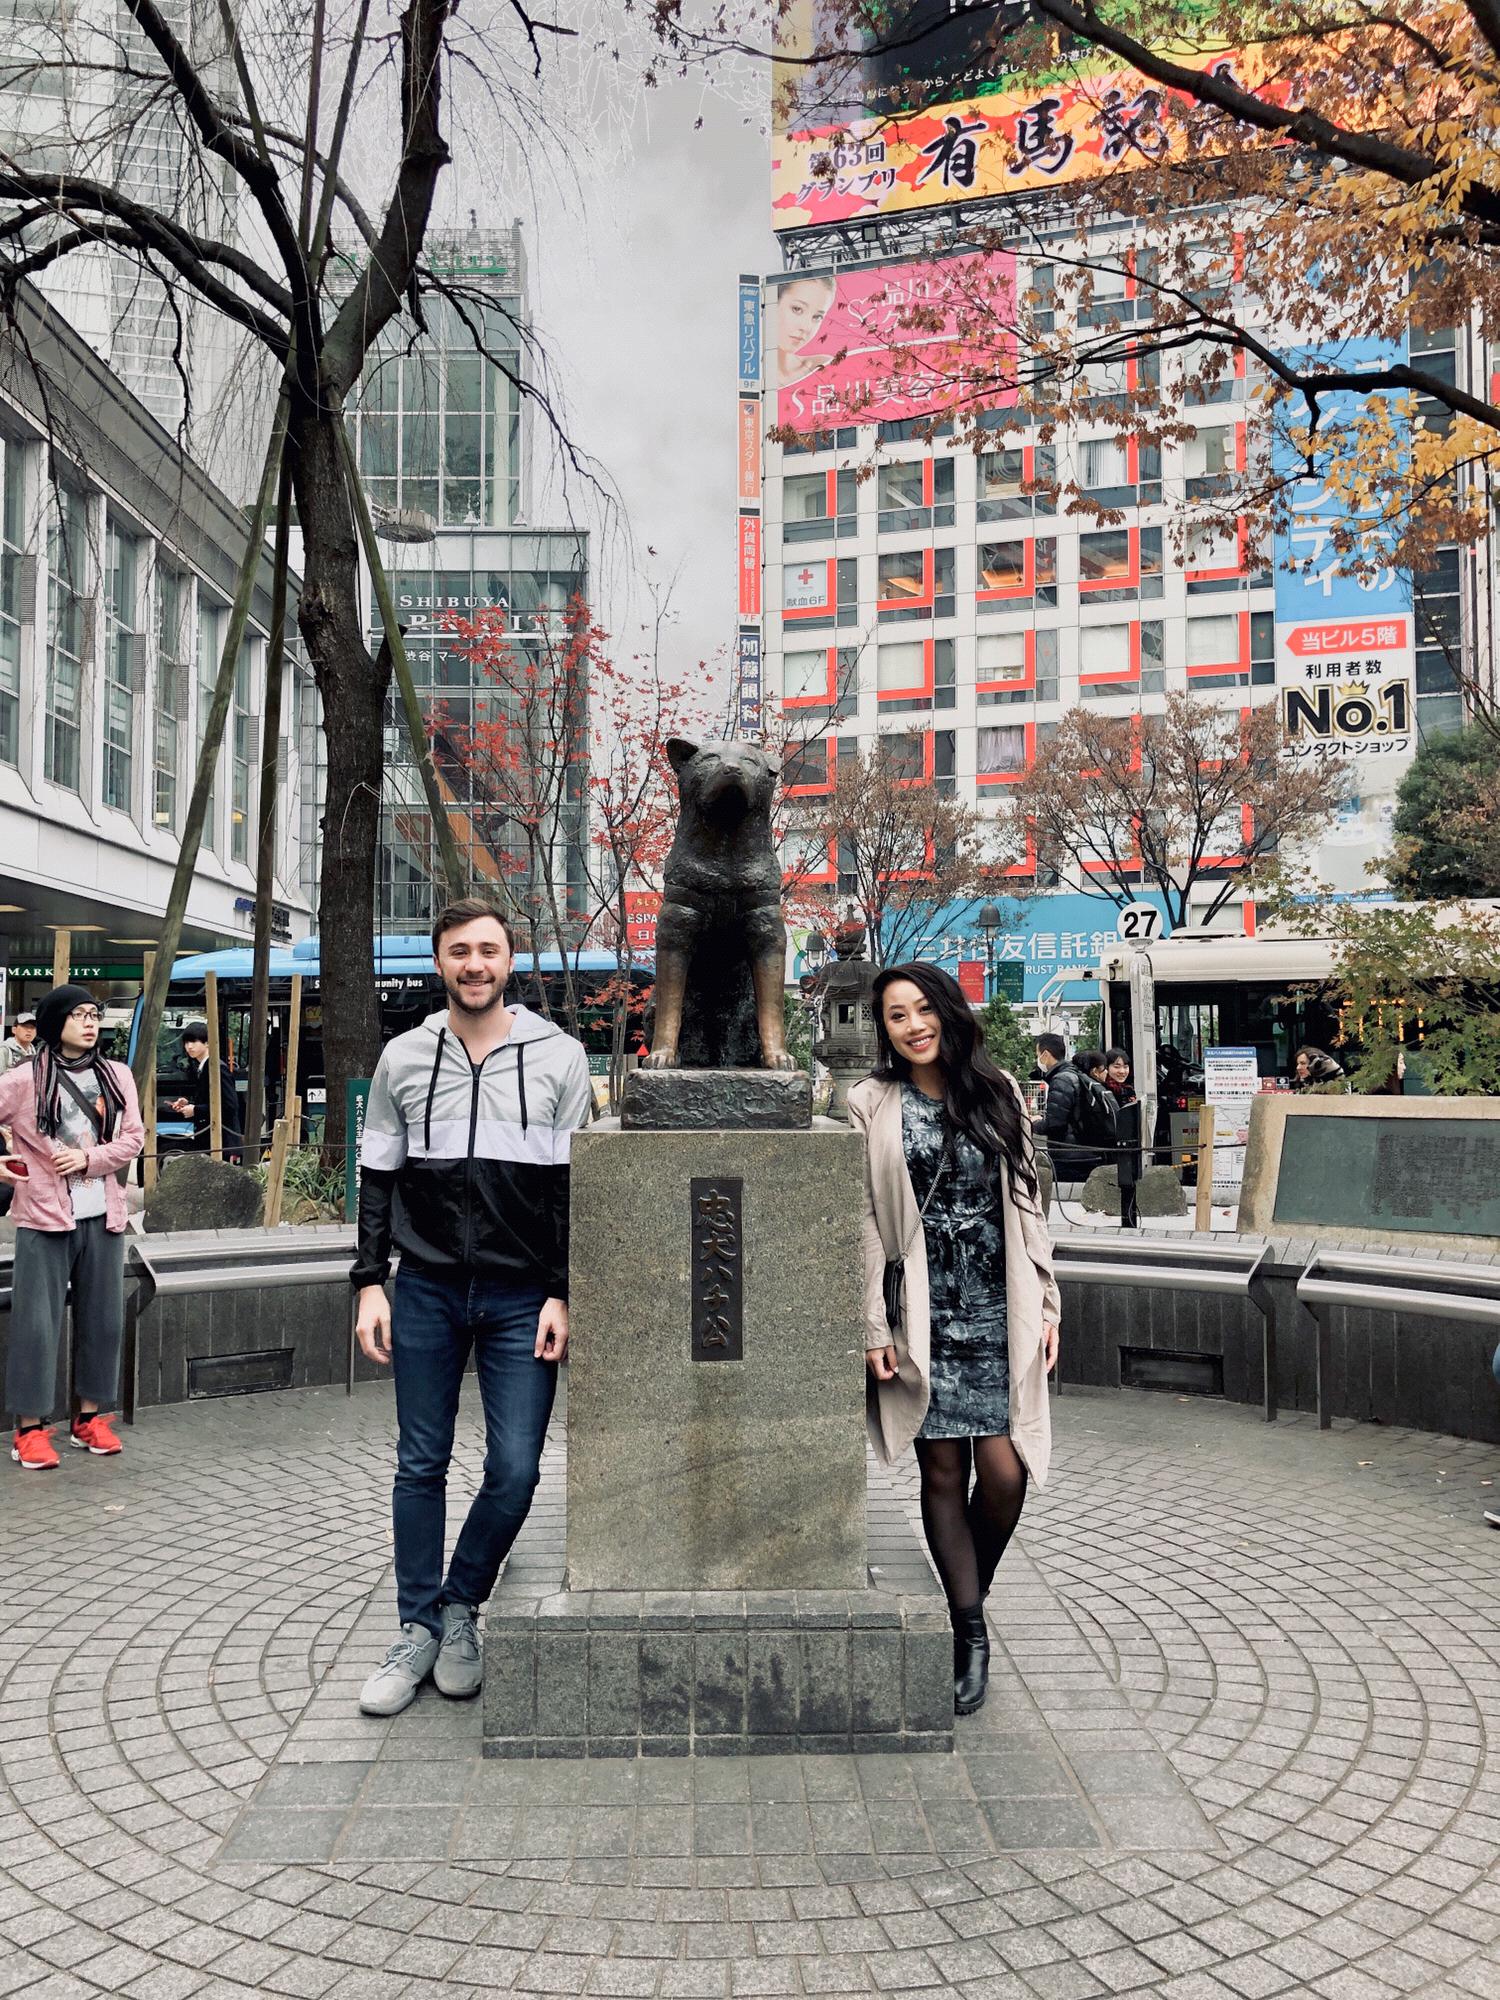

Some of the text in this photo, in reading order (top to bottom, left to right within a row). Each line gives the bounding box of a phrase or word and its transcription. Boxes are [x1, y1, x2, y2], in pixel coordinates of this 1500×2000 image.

[797, 165, 897, 204] グランプリ
[743, 300, 756, 374] 東急リバブル
[743, 380, 756, 389] 9F
[812, 366, 1006, 416] 品川美容外
[744, 519, 756, 570] 外貨両替
[400, 594, 509, 608] SHIBUYA
[744, 614, 757, 623] 7F
[1302, 625, 1398, 650] 当ビル5階
[405, 650, 431, 662] 渋谷
[741, 639, 759, 722] 加藤眼科
[1306, 660, 1382, 679] 利用者数
[1283, 678, 1411, 739] No.1
[742, 729, 758, 740] 5F
[1283, 736, 1411, 758] コンタクトショップ
[628, 913, 657, 924] ESPA
[1123, 911, 1158, 938] 27
[914, 930, 1120, 963] 三井住友信託銀
[8, 968, 101, 976] MARK ITY
[1024, 965, 1054, 975] RUST
[375, 978, 423, 990] unity bus
[696, 1188, 737, 1348] 忠犬ハチ公
